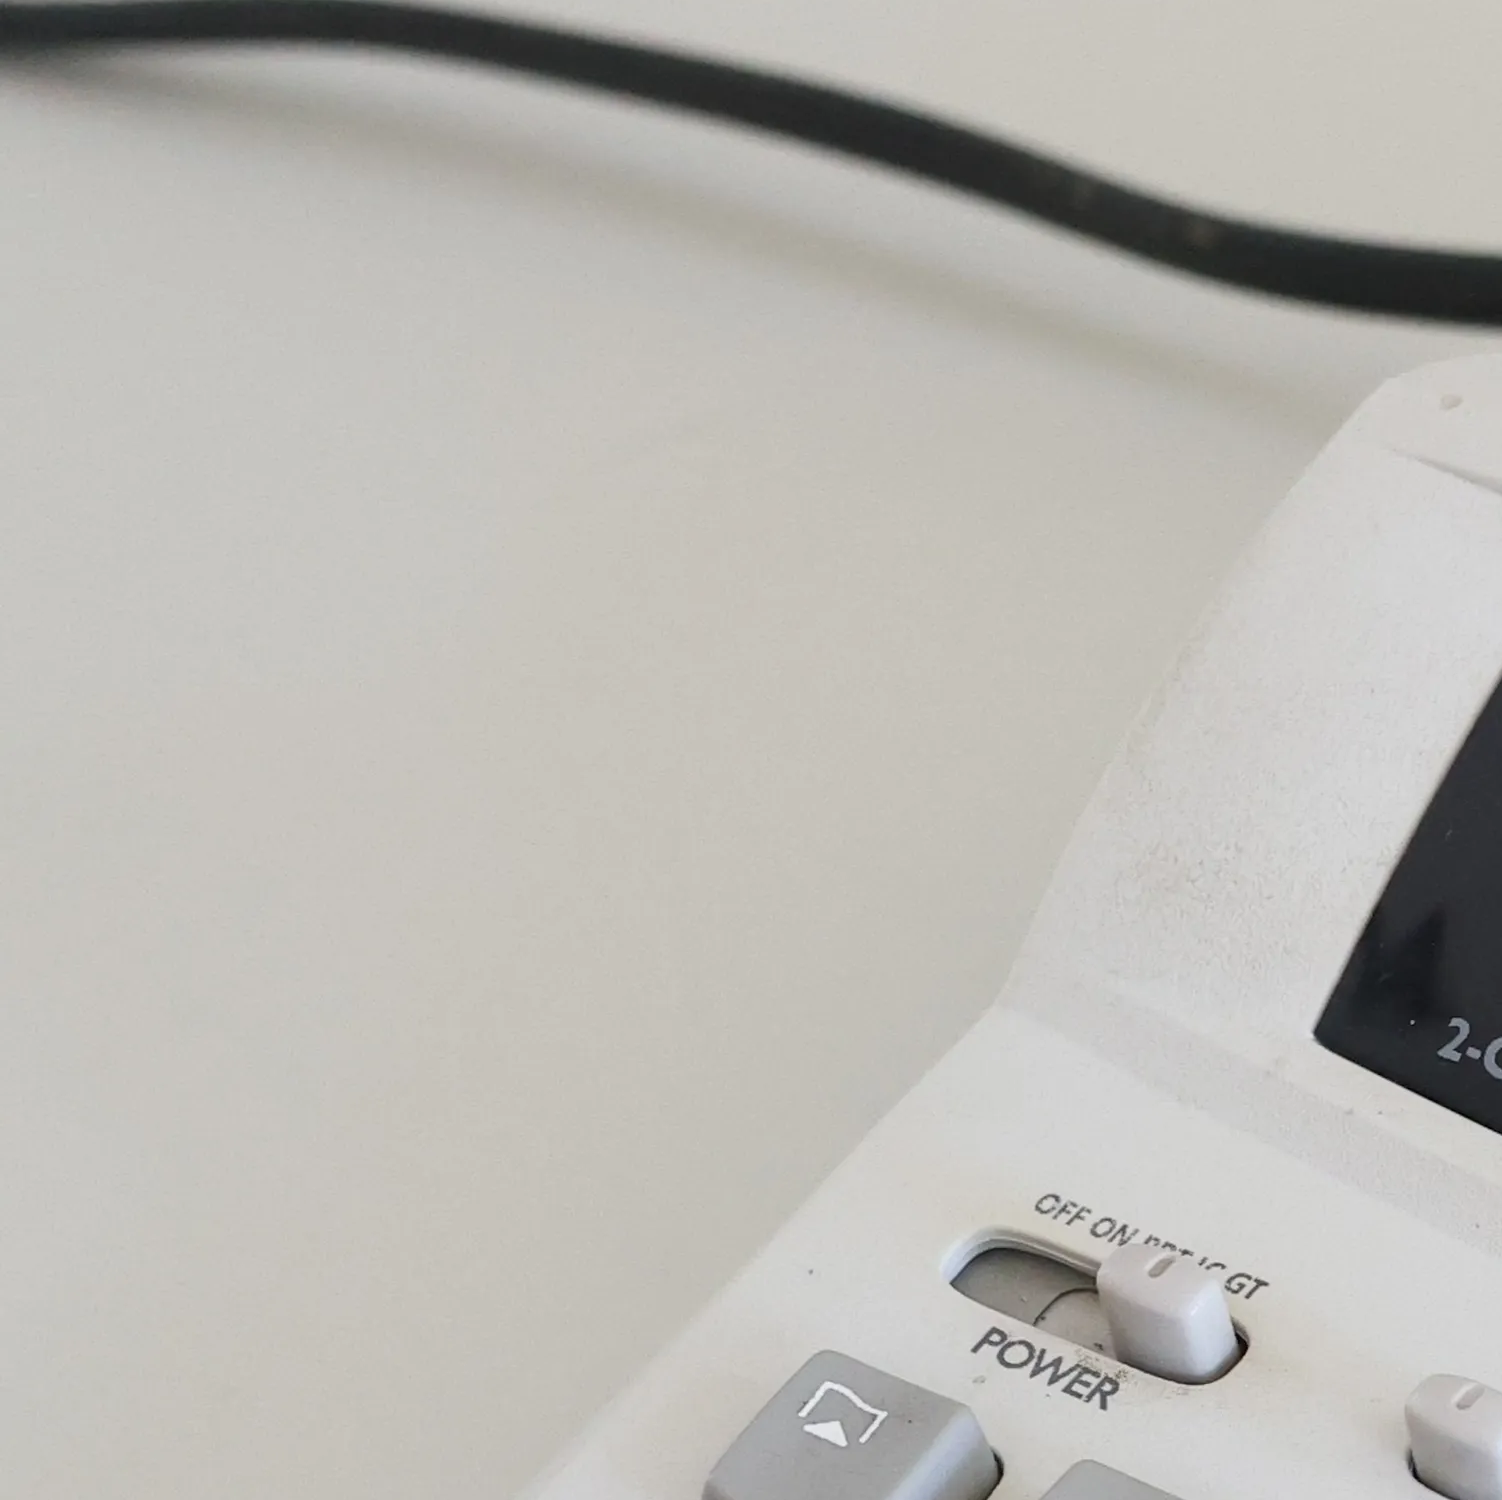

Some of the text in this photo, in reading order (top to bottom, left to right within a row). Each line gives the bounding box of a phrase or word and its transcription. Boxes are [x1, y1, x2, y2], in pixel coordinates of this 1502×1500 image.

[1034, 1193, 1269, 1300] OFF ON GT
[970, 1325, 1122, 1411] POWER
